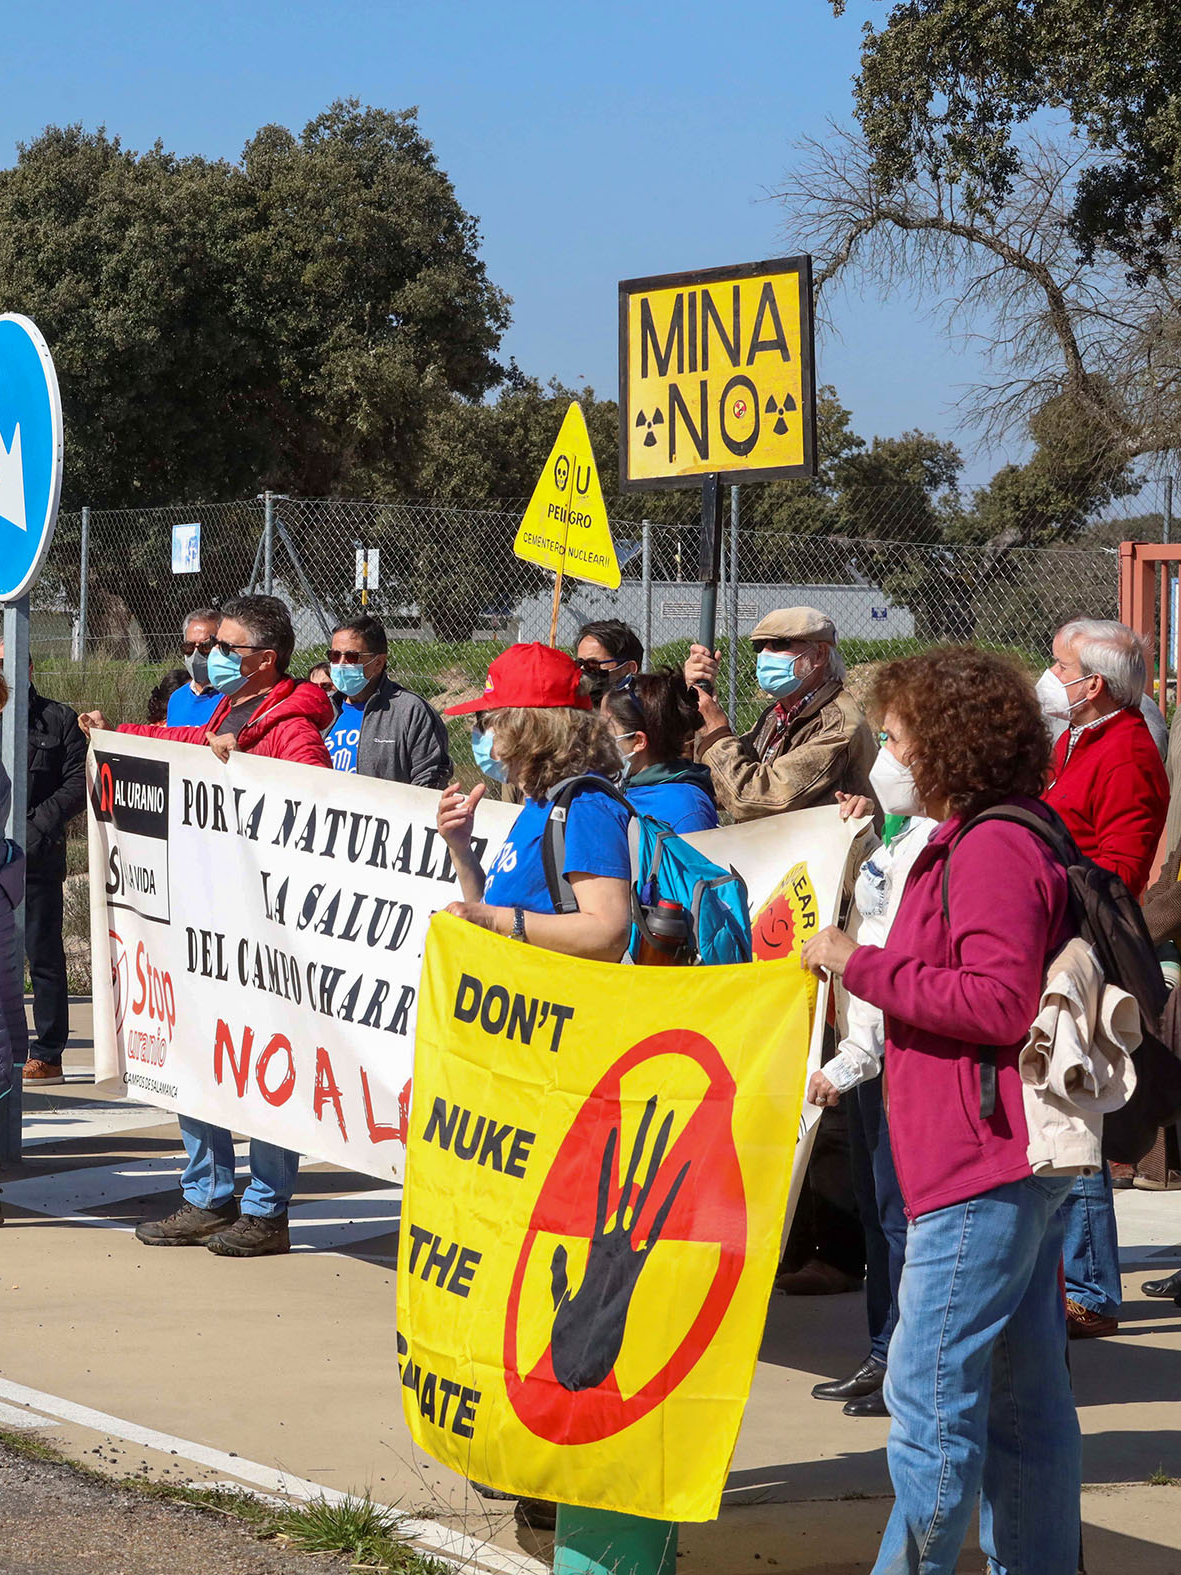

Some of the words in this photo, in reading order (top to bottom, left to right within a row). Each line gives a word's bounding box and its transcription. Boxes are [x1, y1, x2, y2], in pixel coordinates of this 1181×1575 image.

[640, 281, 792, 379] MINA
[669, 374, 760, 464] NO
[324, 729, 360, 751] STO
[114, 779, 126, 807] AL
[127, 781, 165, 814] URANIO
[182, 778, 229, 832] POR
[232, 787, 266, 841] LA
[271, 798, 489, 884] NATURALE
[134, 865, 157, 896] VIDA
[260, 870, 290, 926] LA
[296, 882, 414, 952] SALUD
[132, 940, 176, 1044] Stop
[185, 926, 229, 982] DEL
[237, 937, 302, 1006] CAMPO
[306, 961, 416, 1036] CHARR
[453, 972, 575, 1053] DON'T
[127, 1027, 168, 1068] uranio
[213, 1018, 296, 1108] NO
[312, 1045, 349, 1144] A
[422, 1096, 537, 1180] NUKE
[408, 1224, 482, 1298] THE
